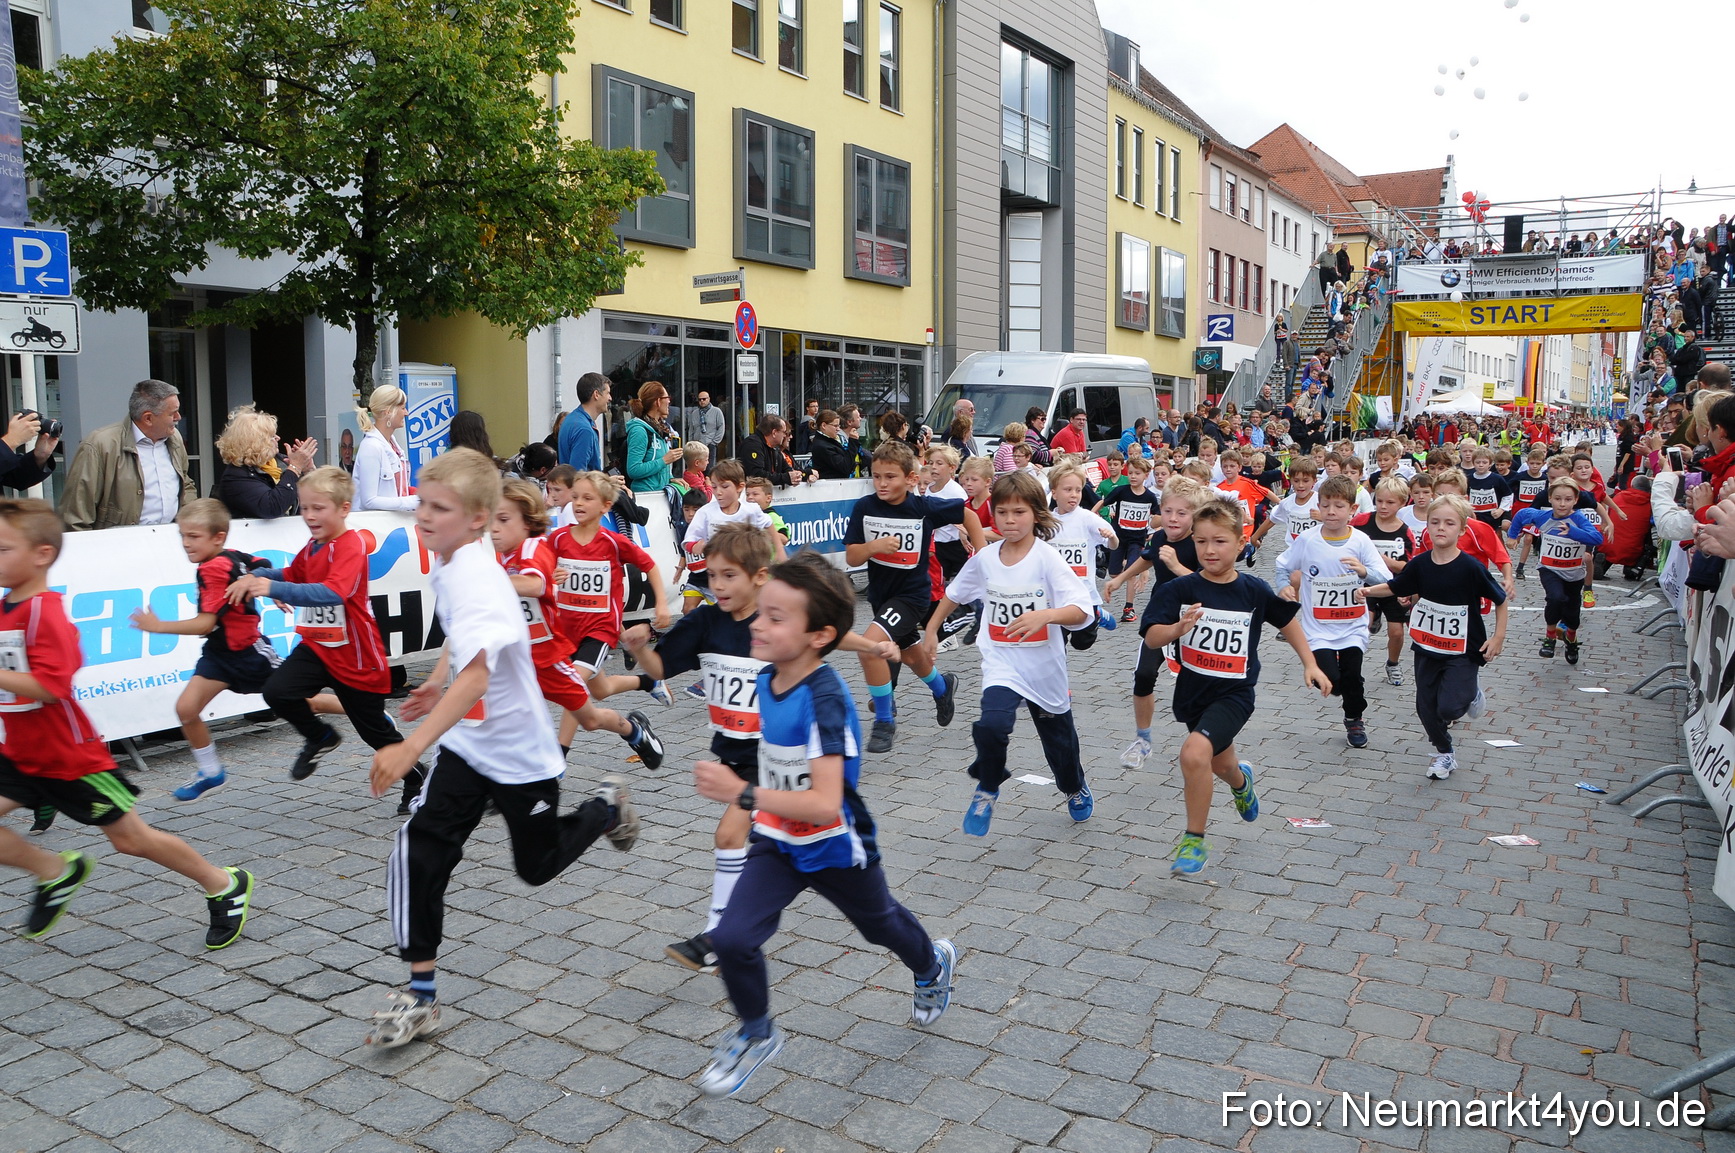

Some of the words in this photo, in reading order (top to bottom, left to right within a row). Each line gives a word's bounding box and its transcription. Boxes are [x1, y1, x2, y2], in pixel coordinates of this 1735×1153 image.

[13, 236, 52, 286] P
[1497, 265, 1595, 278] EfficientDynamics
[693, 274, 738, 286] Brunnwirtsgasse
[1466, 279, 1494, 287] Weniger
[23, 306, 49, 316] nur
[1470, 304, 1554, 325] START
[1415, 382, 1426, 404] Audi
[1471, 495, 1494, 505] 7323
[1123, 509, 1148, 520] 7397
[864, 520, 883, 528] PARTL
[1059, 549, 1083, 564] 26
[1547, 542, 1581, 558] 7087
[568, 595, 592, 606] Lukas
[880, 607, 901, 627] 10
[989, 601, 1035, 625] 7391
[1330, 610, 1349, 618] Felix
[1429, 608, 1458, 616] Neumarkt
[1205, 615, 1241, 626] Neumarkt
[1416, 610, 1460, 636] 7113
[1188, 625, 1243, 654] 7205
[1421, 633, 1451, 648] Vincent
[1196, 654, 1226, 669] Robin
[709, 673, 758, 707] 7127
